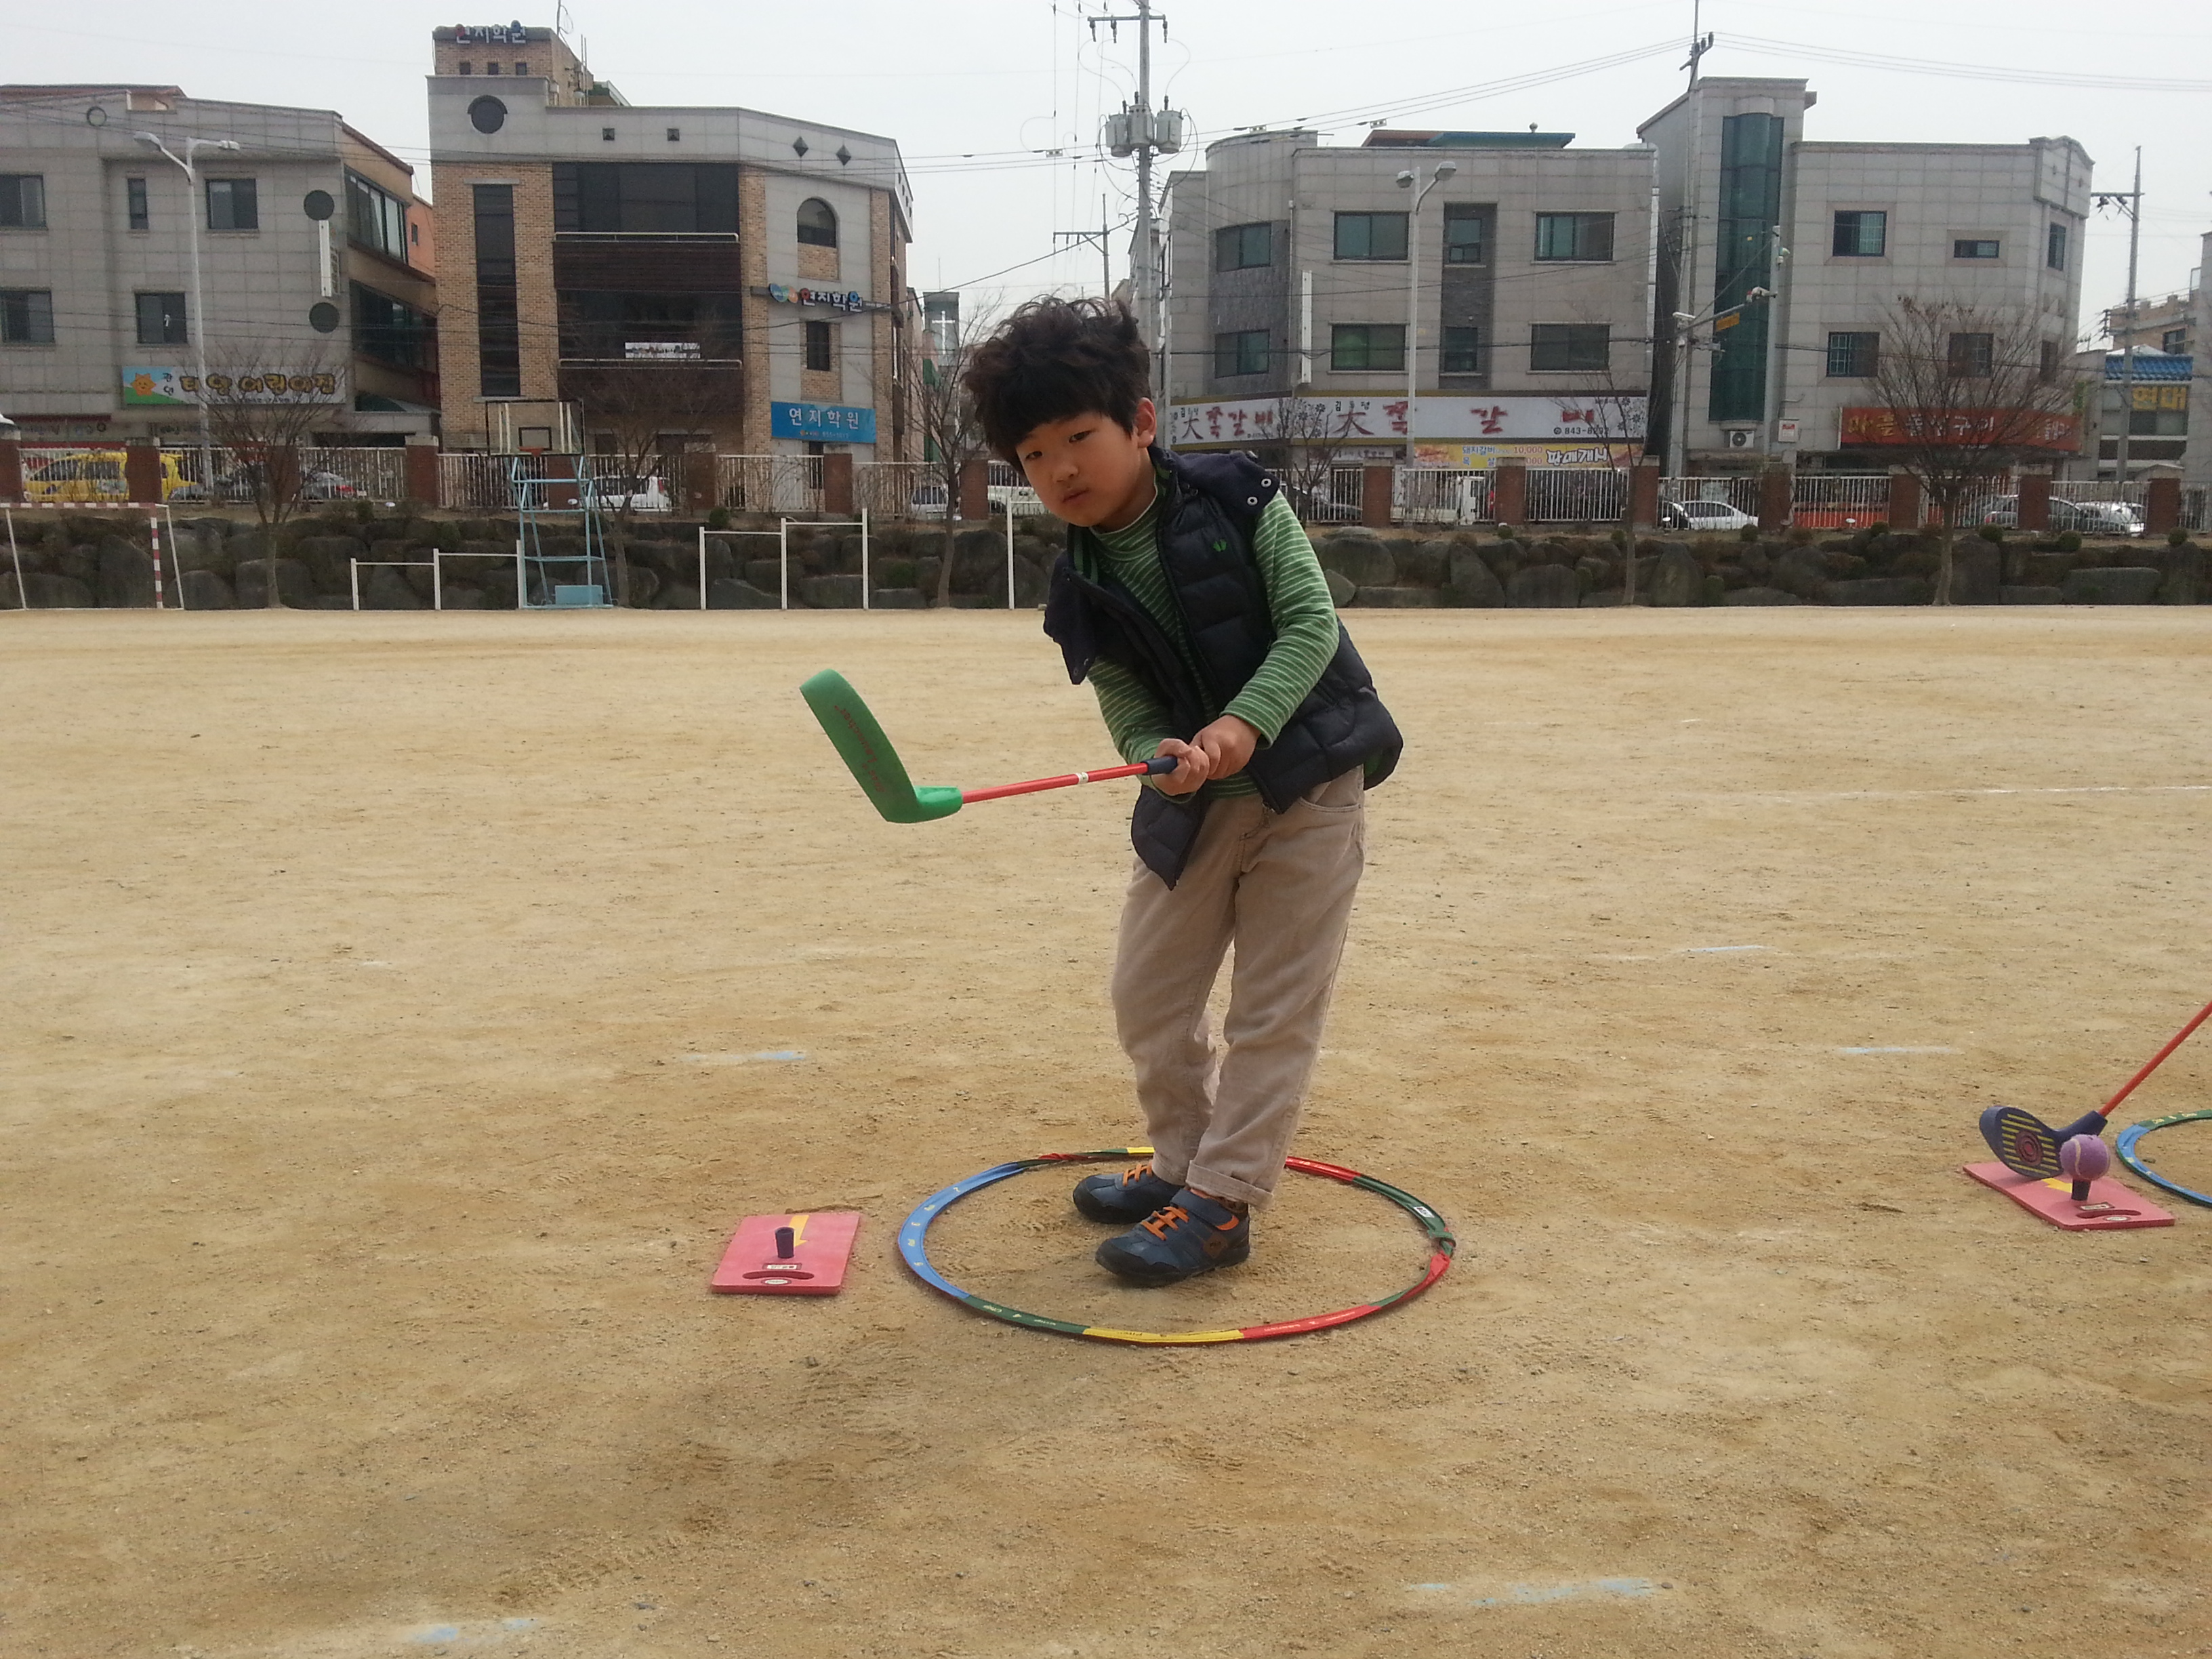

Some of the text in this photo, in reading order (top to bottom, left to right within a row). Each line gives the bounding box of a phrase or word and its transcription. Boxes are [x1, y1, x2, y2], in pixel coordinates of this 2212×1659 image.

[455, 20, 526, 44] 연지학원
[800, 287, 862, 312] 연지학원
[789, 407, 859, 430] 연지학원
[1462, 446, 1495, 455] 돼지갈비
